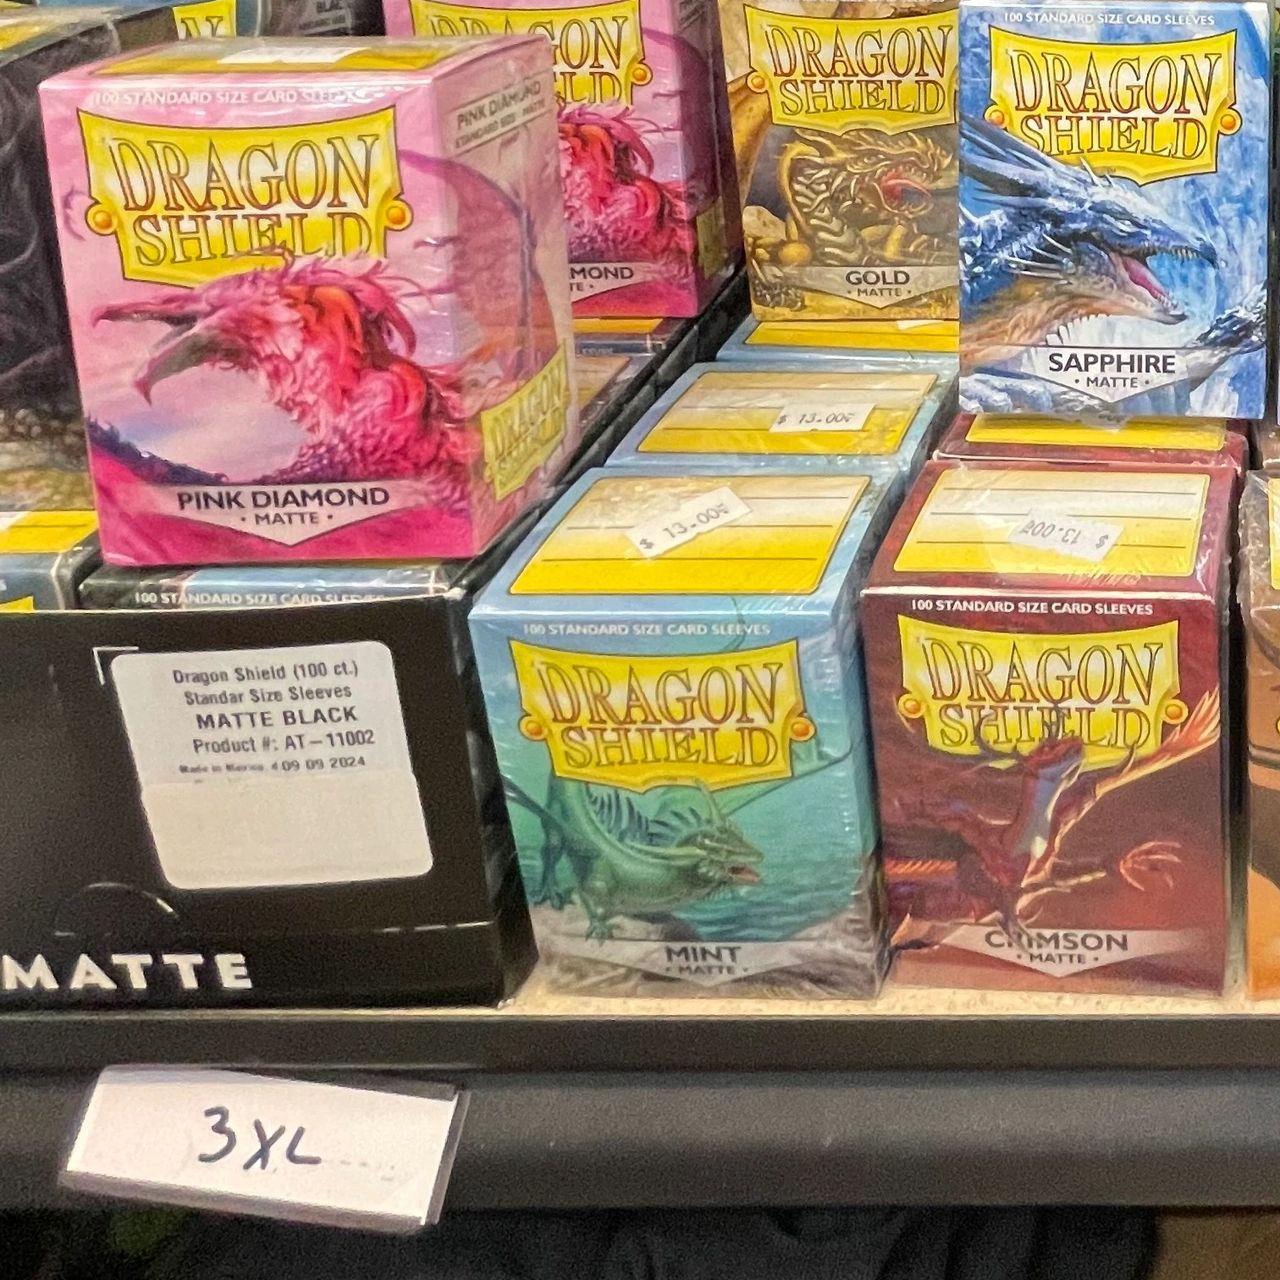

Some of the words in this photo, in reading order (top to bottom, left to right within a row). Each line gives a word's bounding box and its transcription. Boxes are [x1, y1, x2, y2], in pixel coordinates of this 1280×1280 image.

[1003, 12, 1023, 24] 100
[1025, 12, 1094, 25] STANDARD
[1097, 13, 1123, 25] SIZE
[1126, 13, 1161, 25] CARD
[1164, 13, 1216, 26] SLEEVES
[760, 24, 954, 79] DRAGON
[1006, 48, 1222, 115] DRAGON
[95, 92, 120, 105] 100
[123, 92, 210, 105] STANDARD
[215, 91, 249, 104] SIZE
[253, 90, 297, 103] CARD
[779, 79, 946, 116] SHIELD
[1019, 114, 1208, 159] SHIELD
[107, 134, 380, 213] DRAGON
[132, 211, 373, 266] SHIELD
[845, 269, 911, 287] GOLD
[856, 287, 902, 299] MATTE
[1048, 352, 1177, 375] SAPPHIRE
[1086, 376, 1139, 389] MATTE
[778, 414, 787, 425] $
[178, 491, 247, 511] PINK
[251, 486, 391, 510] DIAMOND
[254, 511, 320, 526] MATTE
[639, 538, 654, 550] $
[1095, 534, 1109, 550] $
[134, 591, 158, 604] 100
[160, 591, 243, 604] STANDARD
[245, 592, 278, 605] SIZE
[280, 594, 323, 606] CARD
[911, 599, 934, 612] 100
[935, 599, 1014, 613] STANDARD
[1017, 601, 1049, 614] SIZE
[1051, 602, 1092, 615] CARD
[1095, 603, 1154, 616] SLEEVES
[523, 623, 545, 635] 100
[548, 623, 630, 636] STANDARD
[632, 623, 662, 635] SIZE
[667, 623, 708, 636] CARD
[711, 623, 771, 636] SLEEVES
[173, 667, 229, 687] Dragon
[235, 665, 287, 682] Shield
[292, 663, 328, 681] (100
[333, 660, 359, 678] ct.)
[917, 637, 1164, 706] DRAGON
[184, 689, 245, 706] Standar
[250, 687, 283, 704] Size
[289, 685, 353, 701] Sleeves
[535, 661, 785, 726] DRAGON
[195, 711, 276, 730] MATTE
[282, 705, 358, 727] BLACK
[940, 703, 1152, 748] SHIELD
[193, 736, 258, 754] Product
[262, 736, 279, 752] #:
[561, 724, 780, 769] SHIELD
[281, 759, 300, 772] 09
[305, 758, 325, 771] 09
[330, 755, 366, 769] 2024
[984, 931, 1129, 952] CRIMSON
[664, 945, 742, 964] MINT
[1029, 952, 1087, 965] MATTE
[0, 952, 254, 990] MATTE
[678, 964, 737, 976] MATTE
[199, 1105, 322, 1171] 3XL
